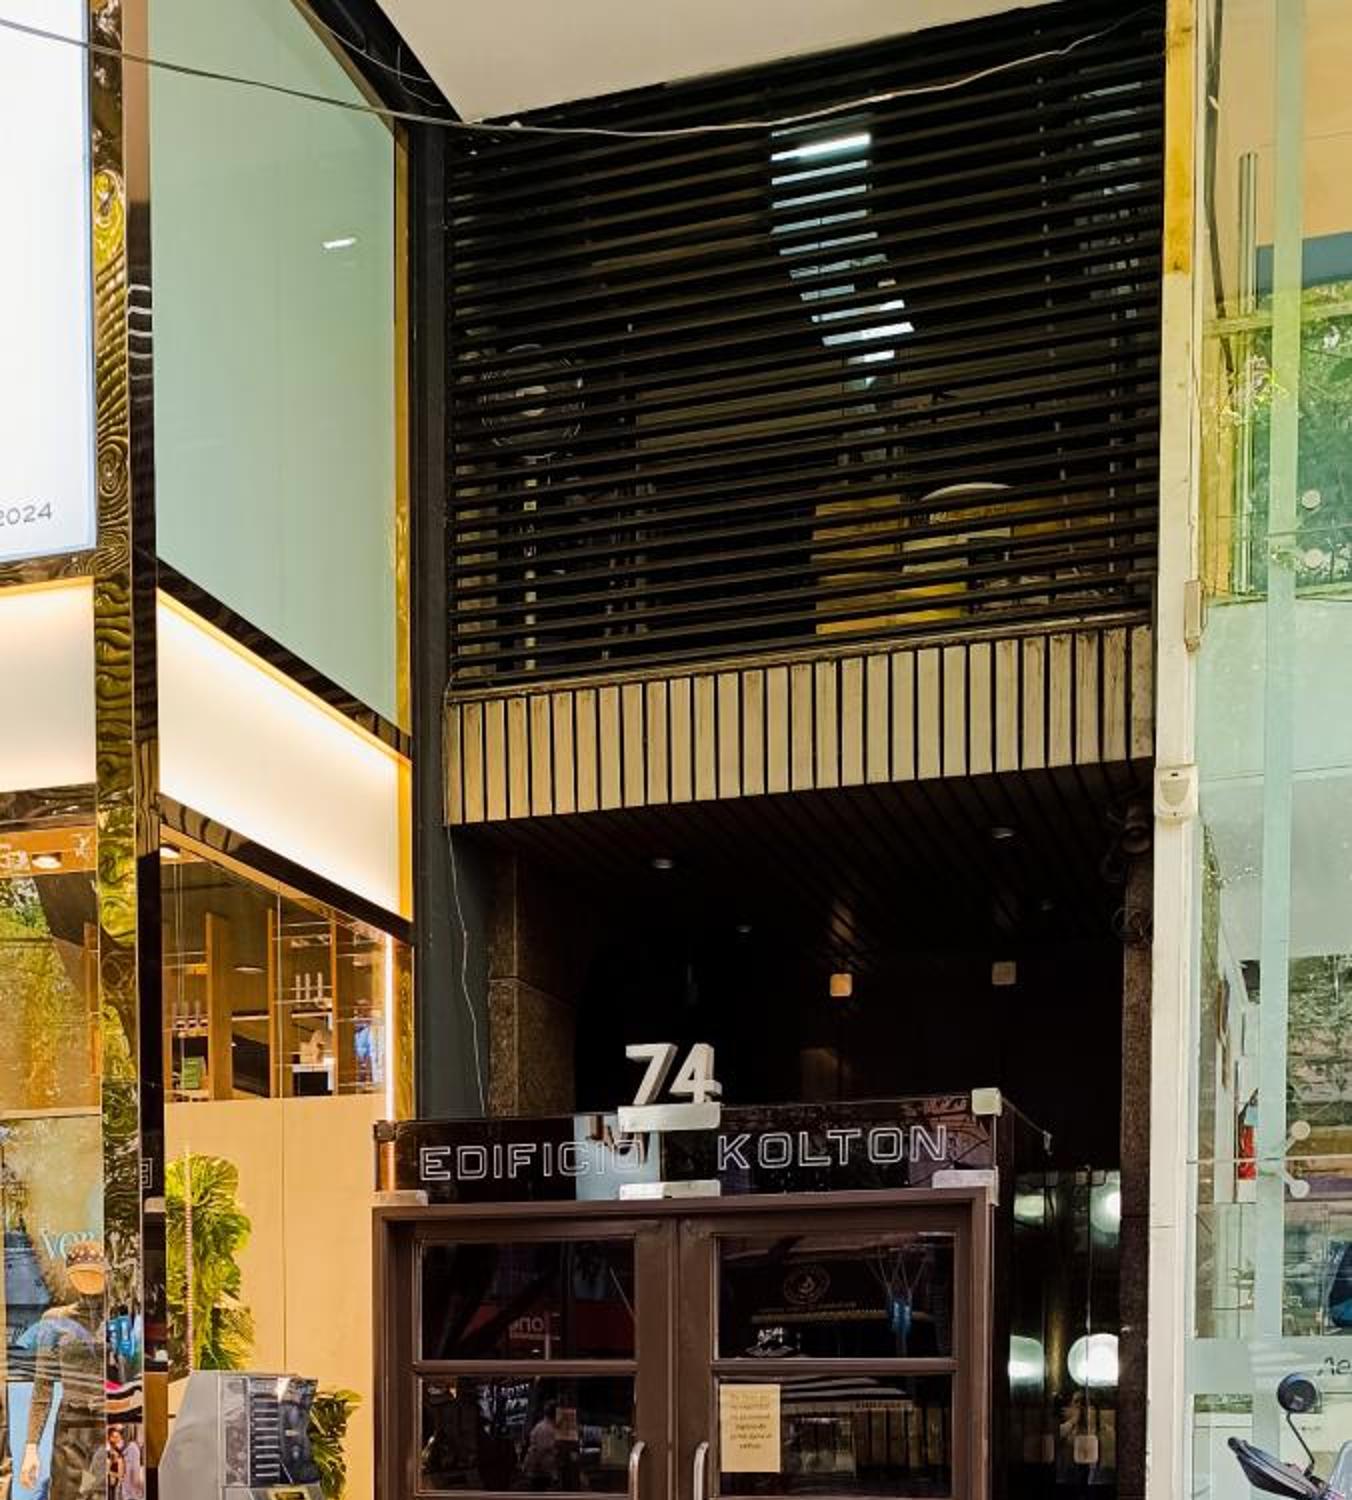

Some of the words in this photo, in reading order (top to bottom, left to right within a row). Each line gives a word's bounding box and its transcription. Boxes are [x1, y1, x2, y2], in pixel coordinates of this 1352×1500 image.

[625, 1042, 722, 1106] 74
[419, 1139, 643, 1182] EDIFICIO
[717, 1125, 947, 1171] KOLTON
